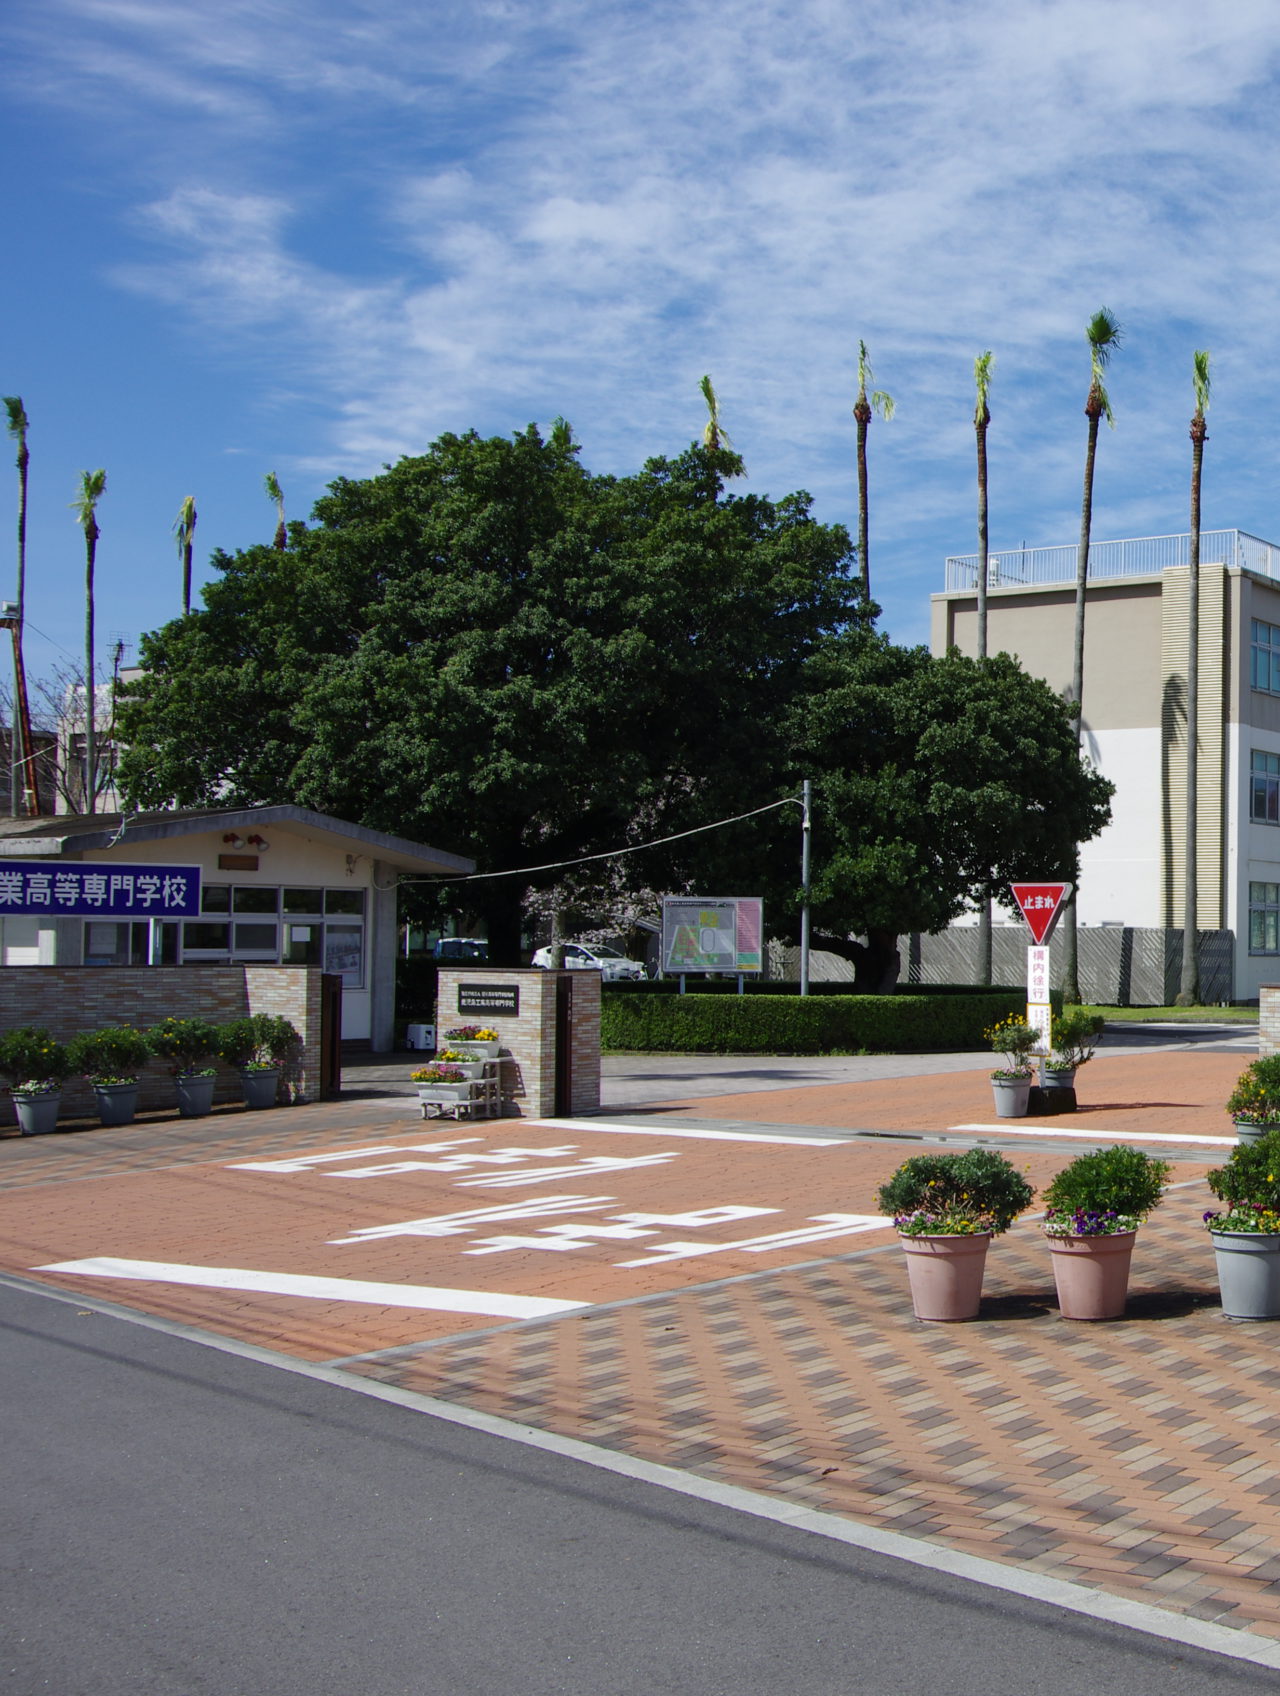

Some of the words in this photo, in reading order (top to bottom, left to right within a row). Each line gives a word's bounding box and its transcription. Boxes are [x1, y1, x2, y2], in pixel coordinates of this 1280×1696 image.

[0, 872, 187, 908] 業高等専門学校
[1023, 895, 1055, 909] 止まれ
[1033, 950, 1045, 999] 構内徐行
